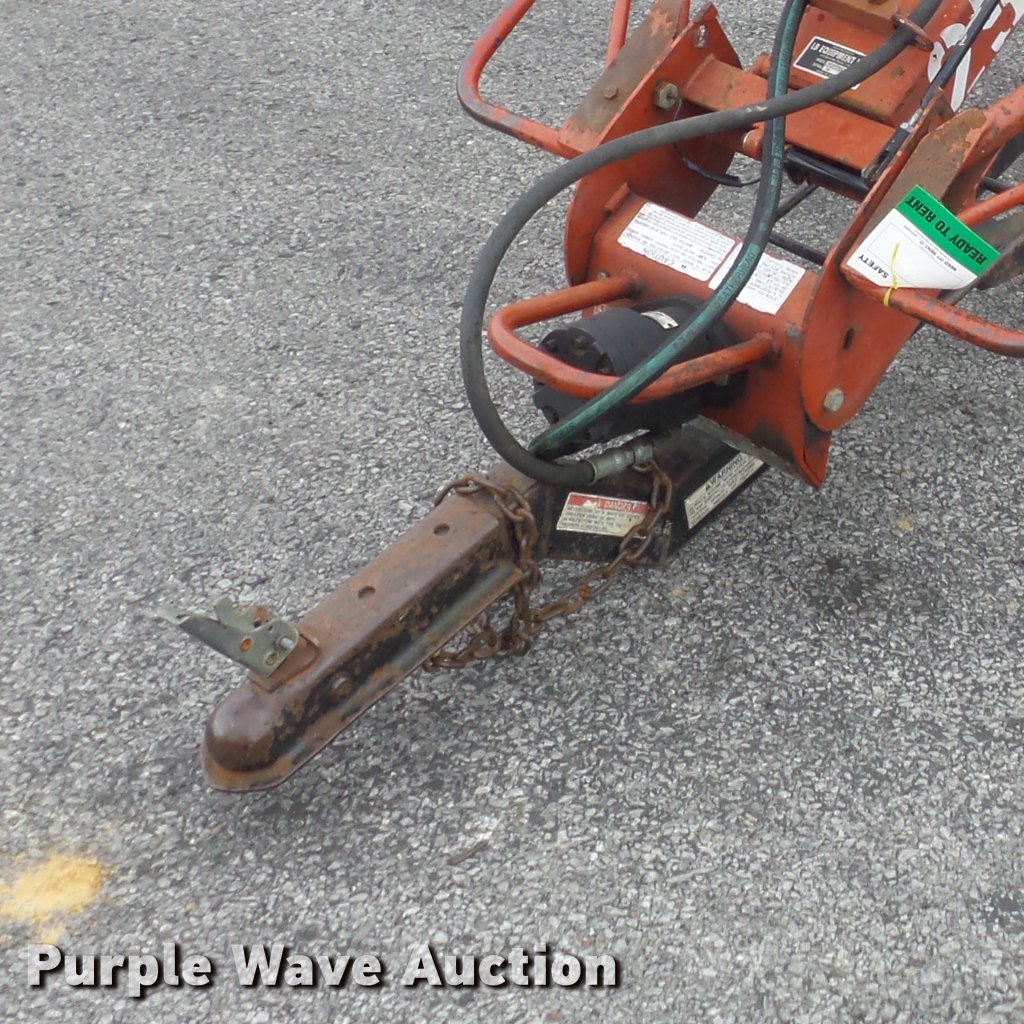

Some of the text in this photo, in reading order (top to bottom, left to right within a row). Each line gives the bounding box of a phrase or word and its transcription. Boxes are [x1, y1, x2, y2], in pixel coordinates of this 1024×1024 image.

[818, 45, 857, 64] EQUIPMENT
[905, 196, 937, 224] RENT
[934, 220, 952, 237] TO
[643, 247, 675, 265] CAUTION
[950, 234, 988, 265] READY
[857, 253, 890, 280] SAFETY
